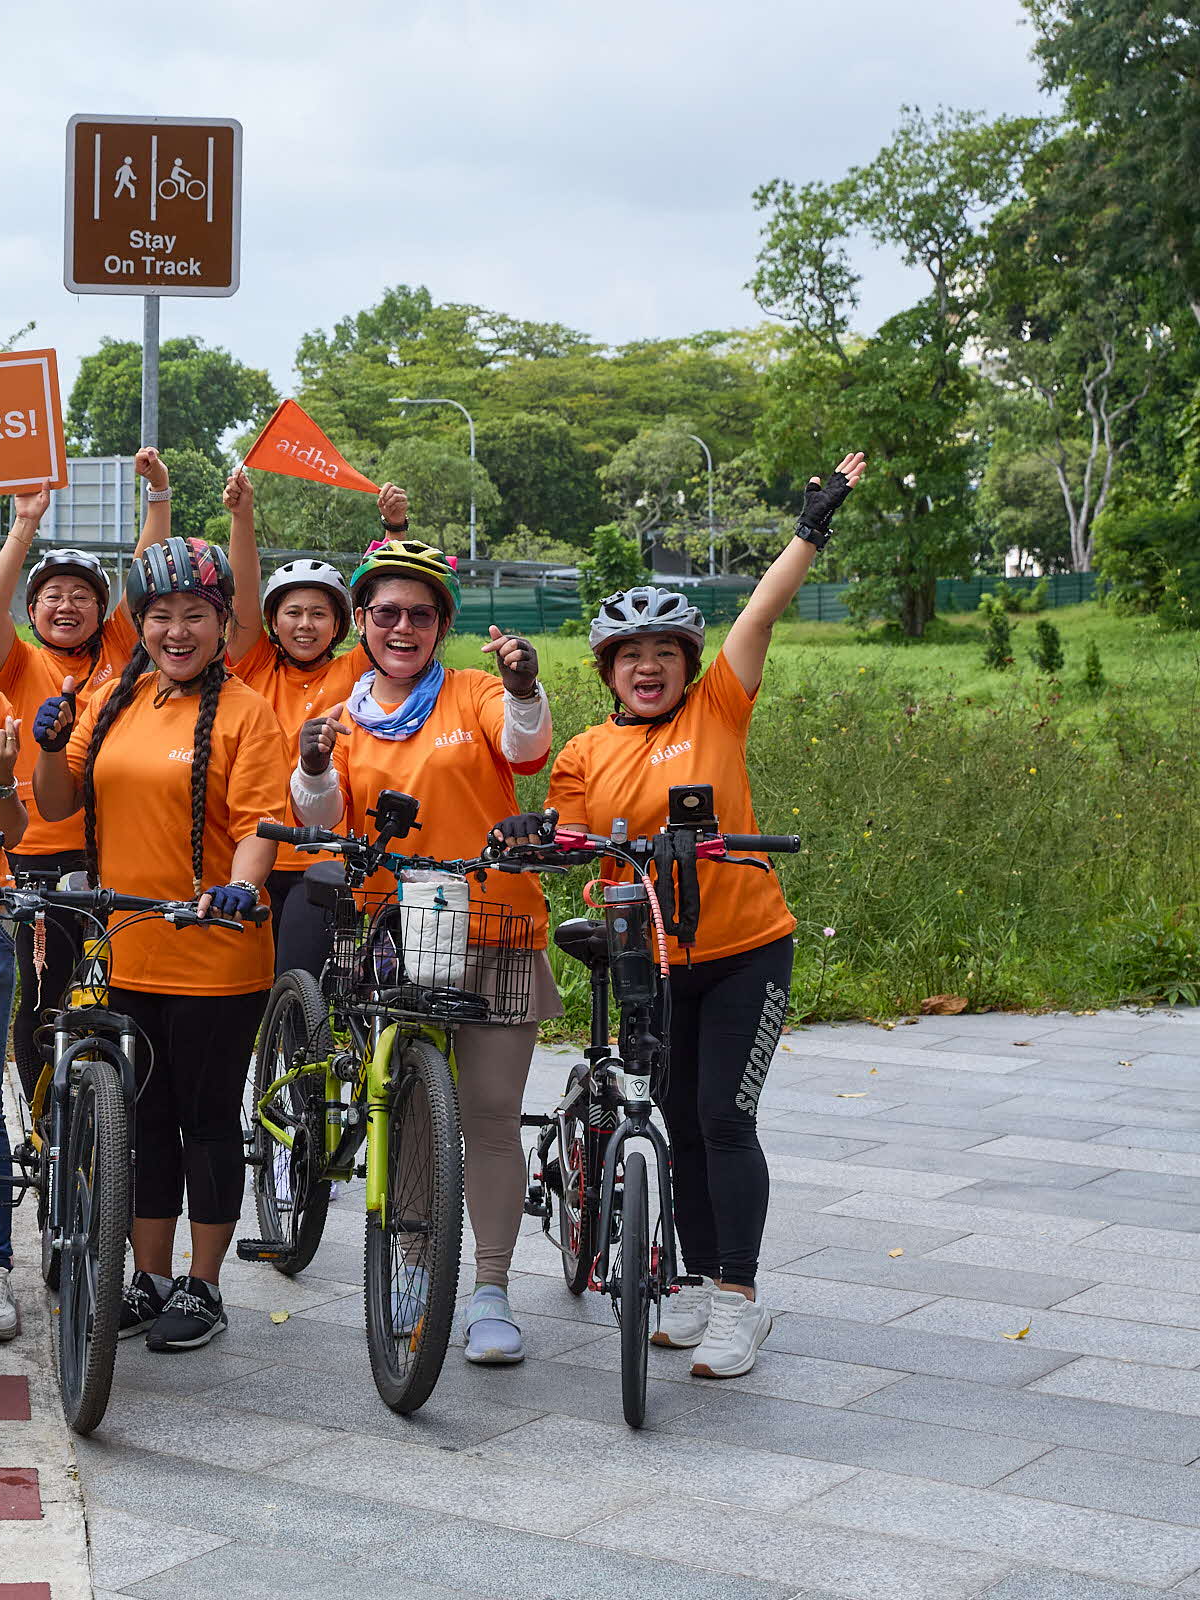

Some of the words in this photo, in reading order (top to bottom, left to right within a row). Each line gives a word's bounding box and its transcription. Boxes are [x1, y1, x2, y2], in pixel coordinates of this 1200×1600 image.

[129, 230, 176, 254] Stay
[104, 256, 134, 274] On
[141, 256, 201, 275] Track
[275, 438, 340, 480] aidha
[435, 729, 472, 747] aidha
[650, 740, 692, 765] aidha
[734, 982, 788, 1117] SKECHERS
